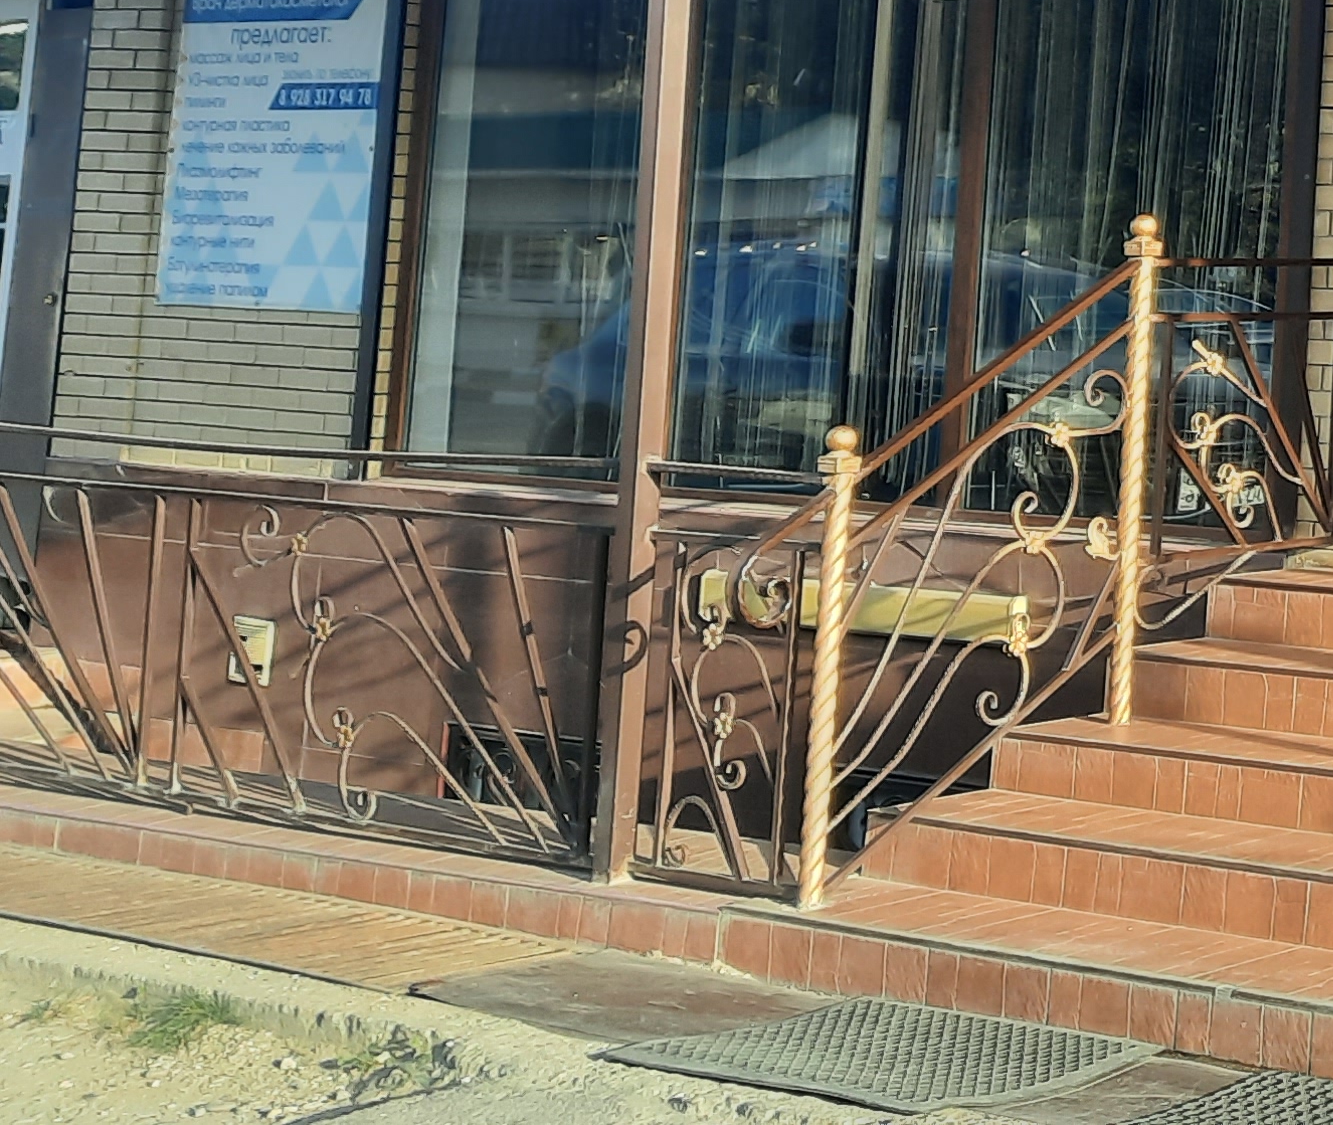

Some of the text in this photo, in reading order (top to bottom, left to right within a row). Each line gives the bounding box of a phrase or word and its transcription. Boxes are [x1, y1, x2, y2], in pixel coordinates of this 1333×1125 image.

[230, 25, 333, 51] предлагает:
[278, 89, 286, 106] 8
[314, 88, 335, 106] 317
[338, 88, 353, 105] 94
[357, 88, 372, 105] 78
